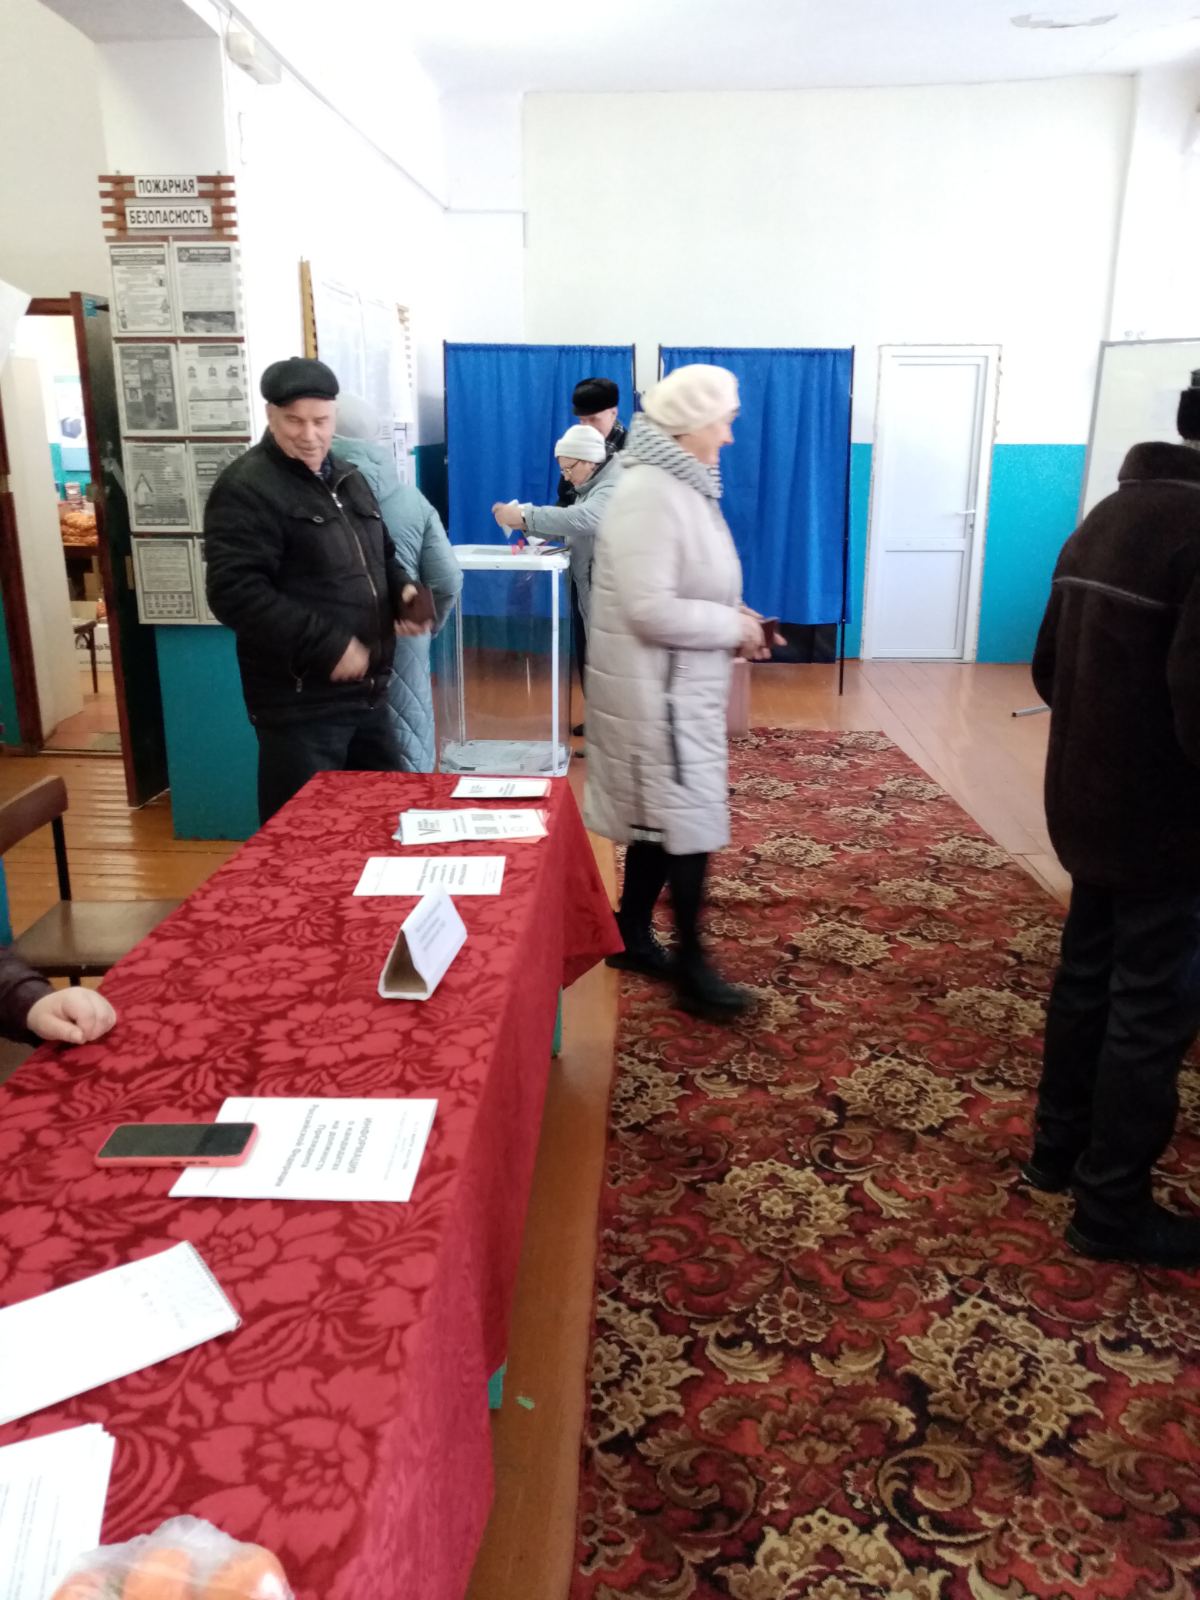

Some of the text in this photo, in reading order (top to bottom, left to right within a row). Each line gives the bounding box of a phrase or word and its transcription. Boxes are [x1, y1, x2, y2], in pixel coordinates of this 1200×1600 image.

[138, 179, 195, 193] ПОЖАРНАЯ
[129, 210, 208, 224] БЕЗОПАСНОСТЬ
[346, 1117, 372, 1174] ИНФОРМАЦИЯ
